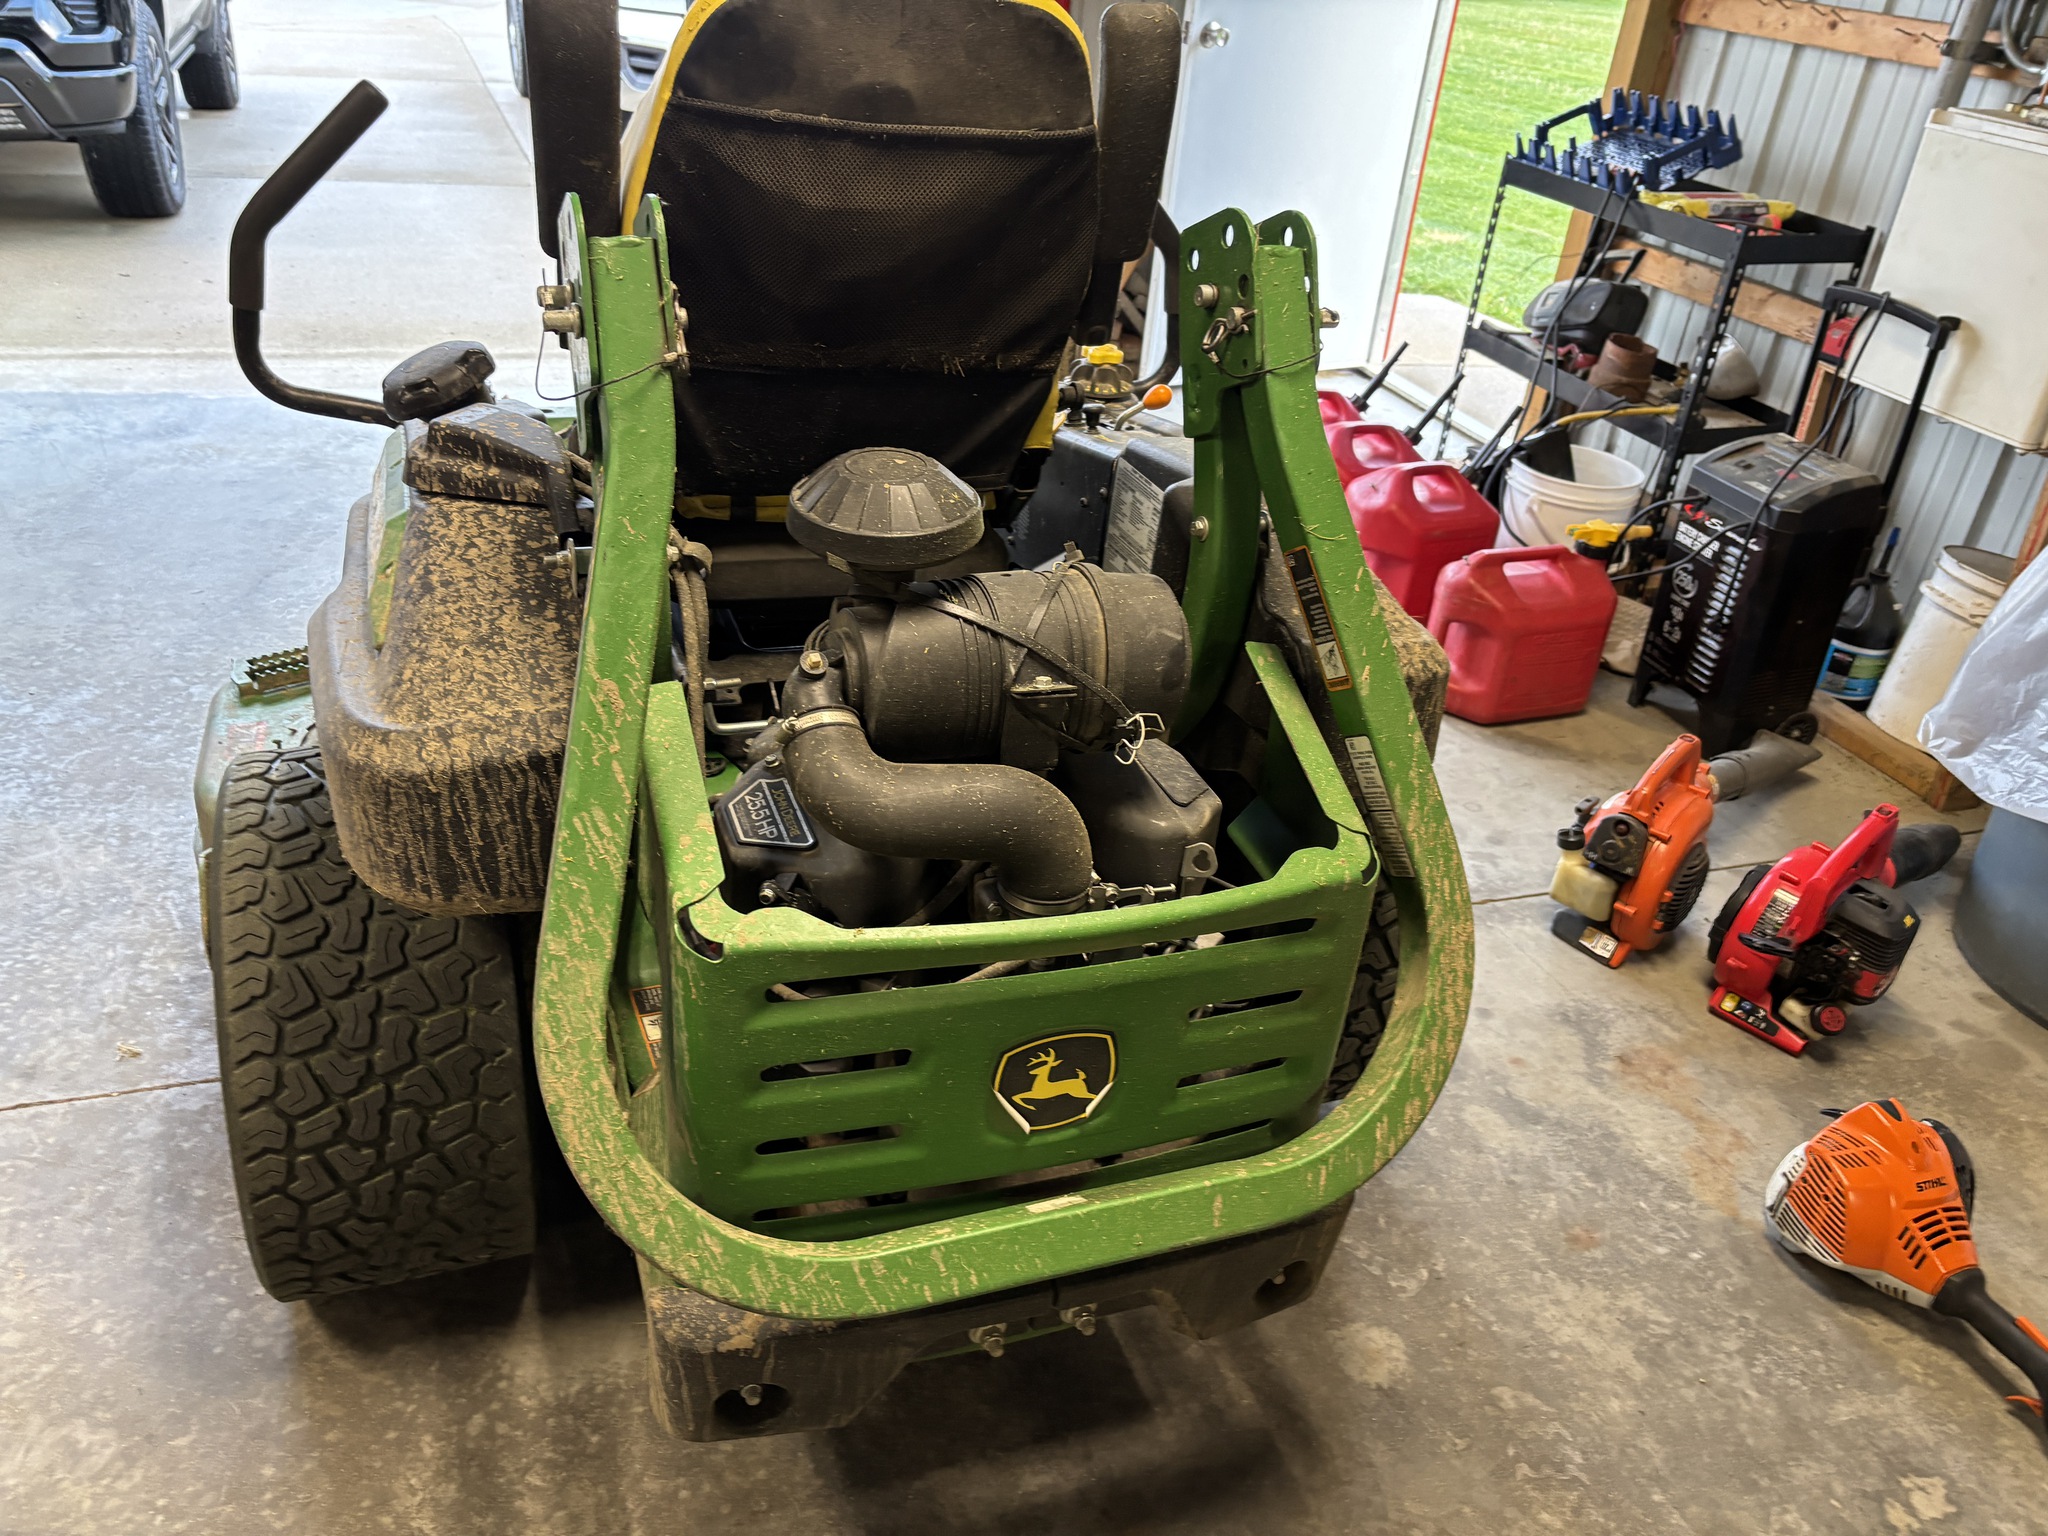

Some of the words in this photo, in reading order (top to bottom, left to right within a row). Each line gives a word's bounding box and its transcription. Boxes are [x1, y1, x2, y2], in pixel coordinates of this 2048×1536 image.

[744, 791, 770, 820] 25.5
[771, 788, 790, 810] JOHN
[755, 818, 778, 838] HP
[780, 808, 800, 837] DEERE
[1915, 1176, 1947, 1192] STIHL
